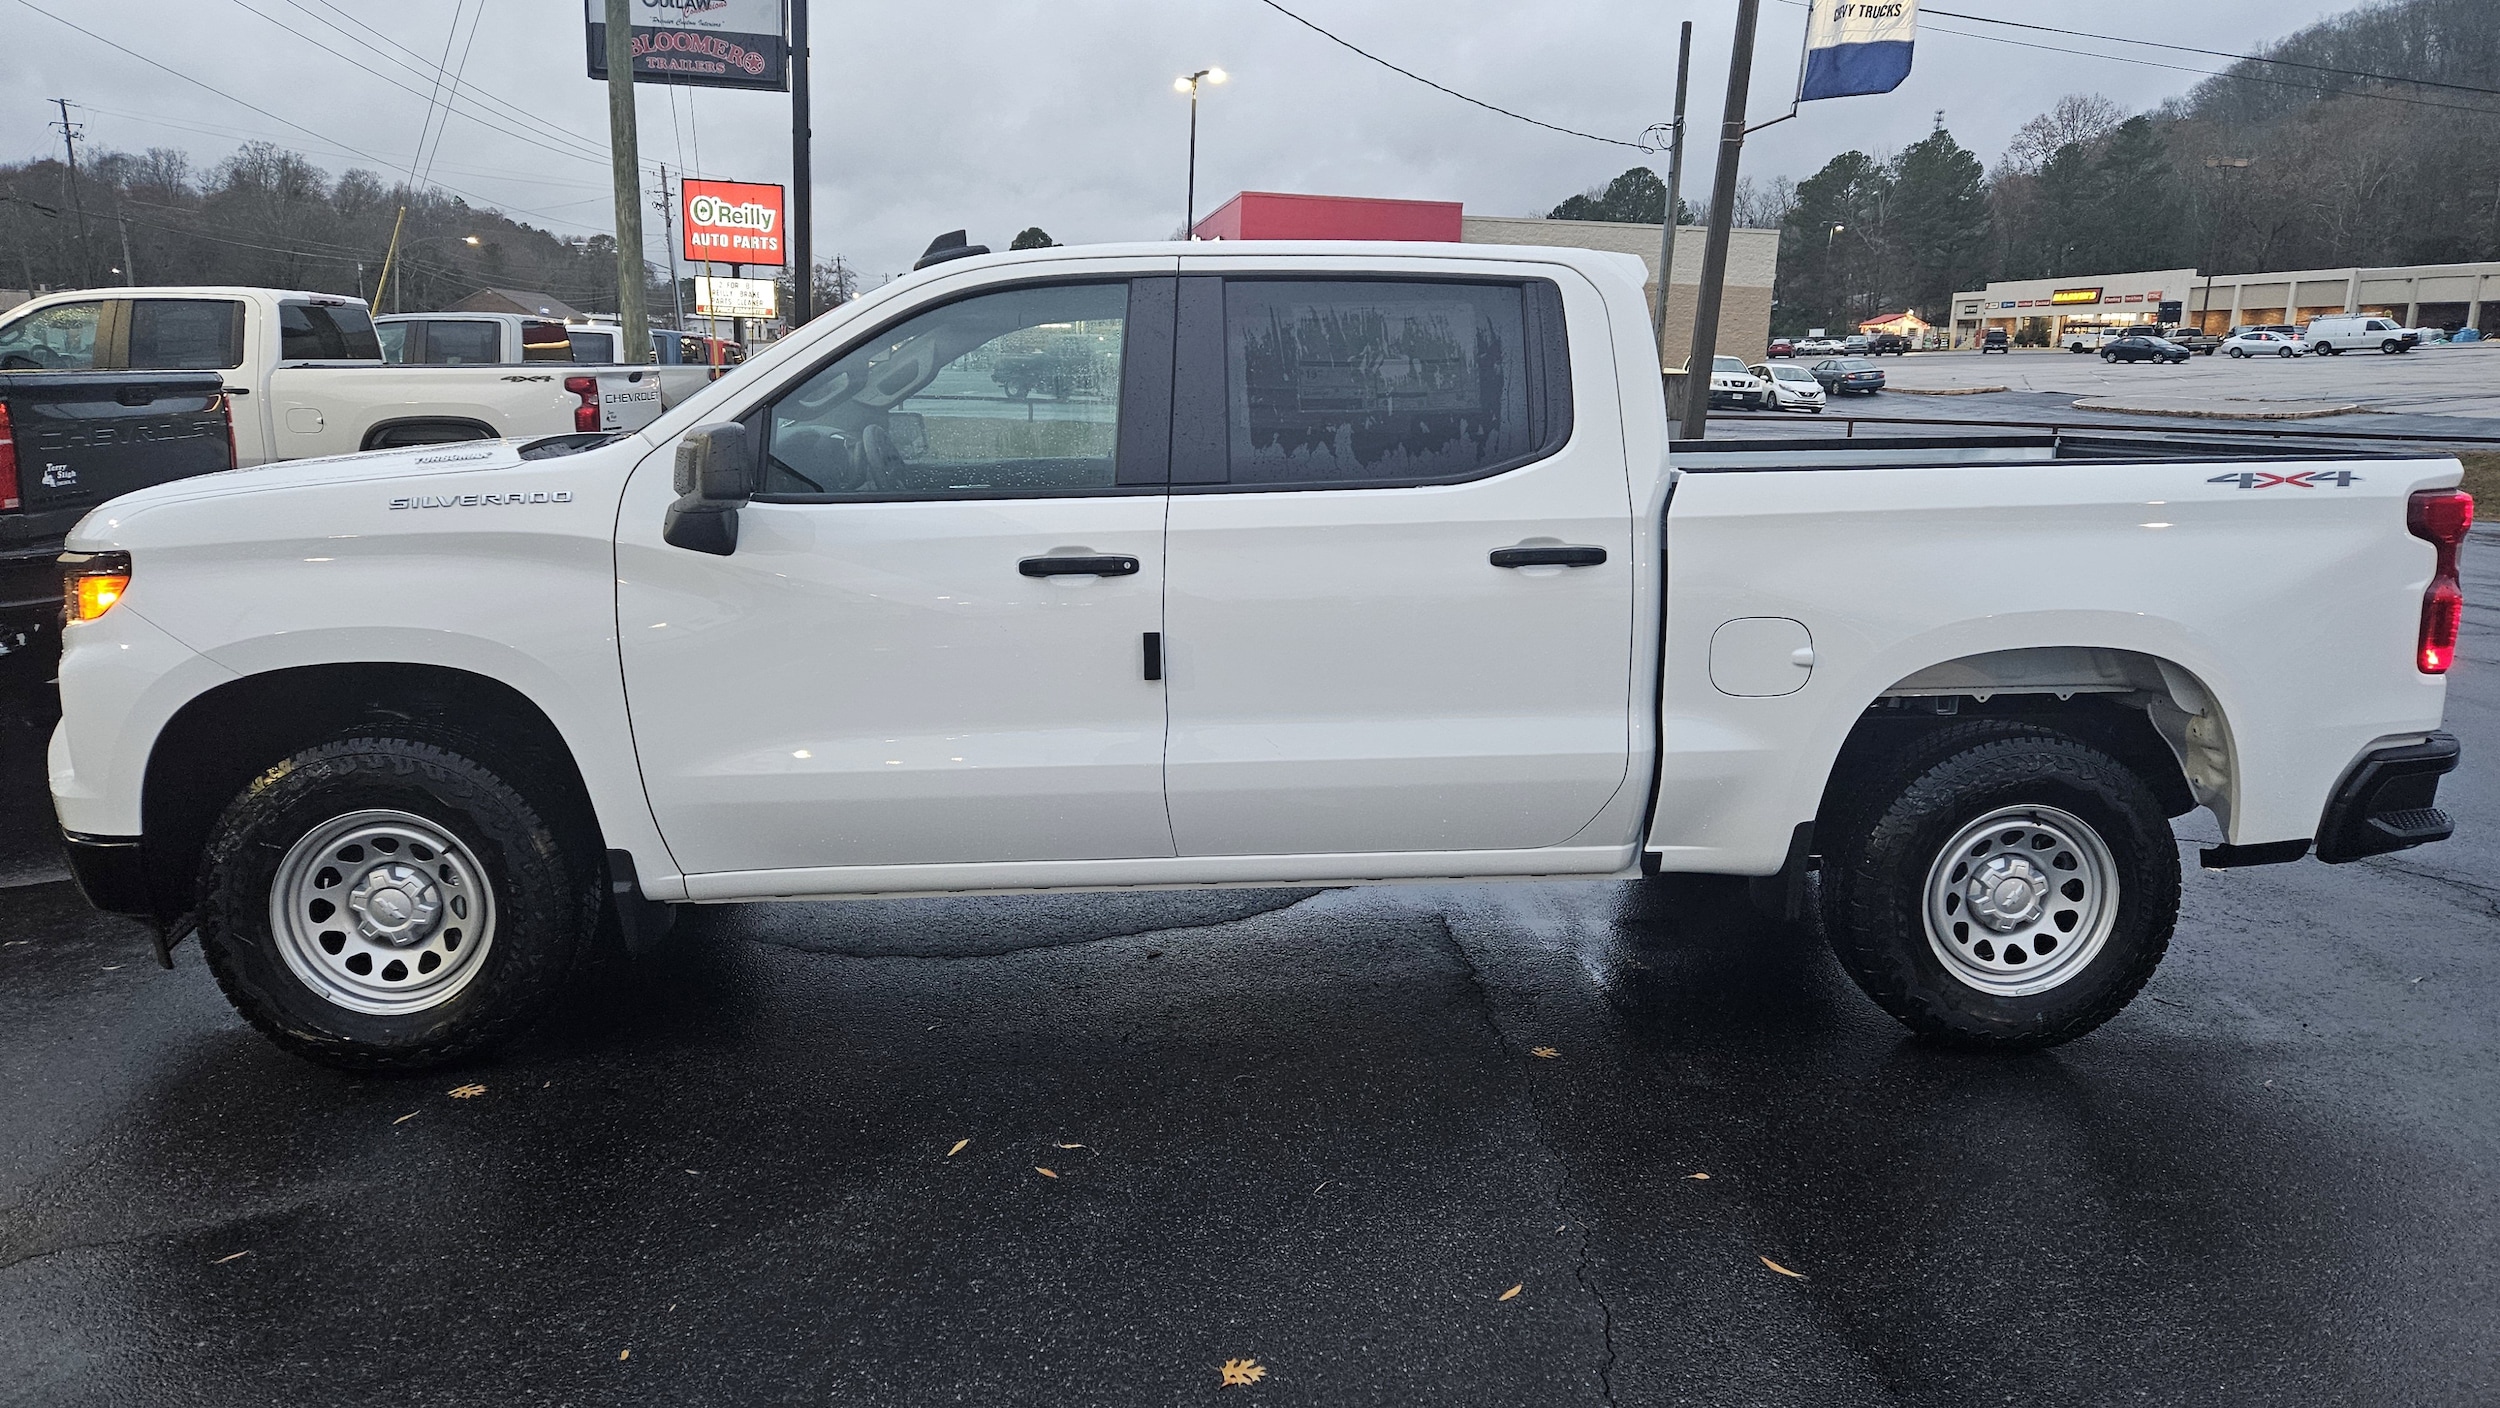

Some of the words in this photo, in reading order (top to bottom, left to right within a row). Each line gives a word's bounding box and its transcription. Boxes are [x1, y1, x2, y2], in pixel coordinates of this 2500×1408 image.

[1859, 3, 1903, 19] TRUCKS
[631, 32, 745, 67] BLOOMER
[646, 56, 726, 74] TRAILERS
[693, 198, 772, 230] O'Reilly
[692, 232, 729, 247] AUTO
[733, 234, 778, 250] PARTS
[726, 281, 739, 289] FOR
[605, 391, 660, 404] CHEVROLET
[39, 420, 219, 451] CHEVROLET
[46, 462, 67, 472] Terry
[388, 490, 573, 510] SILVERADO
